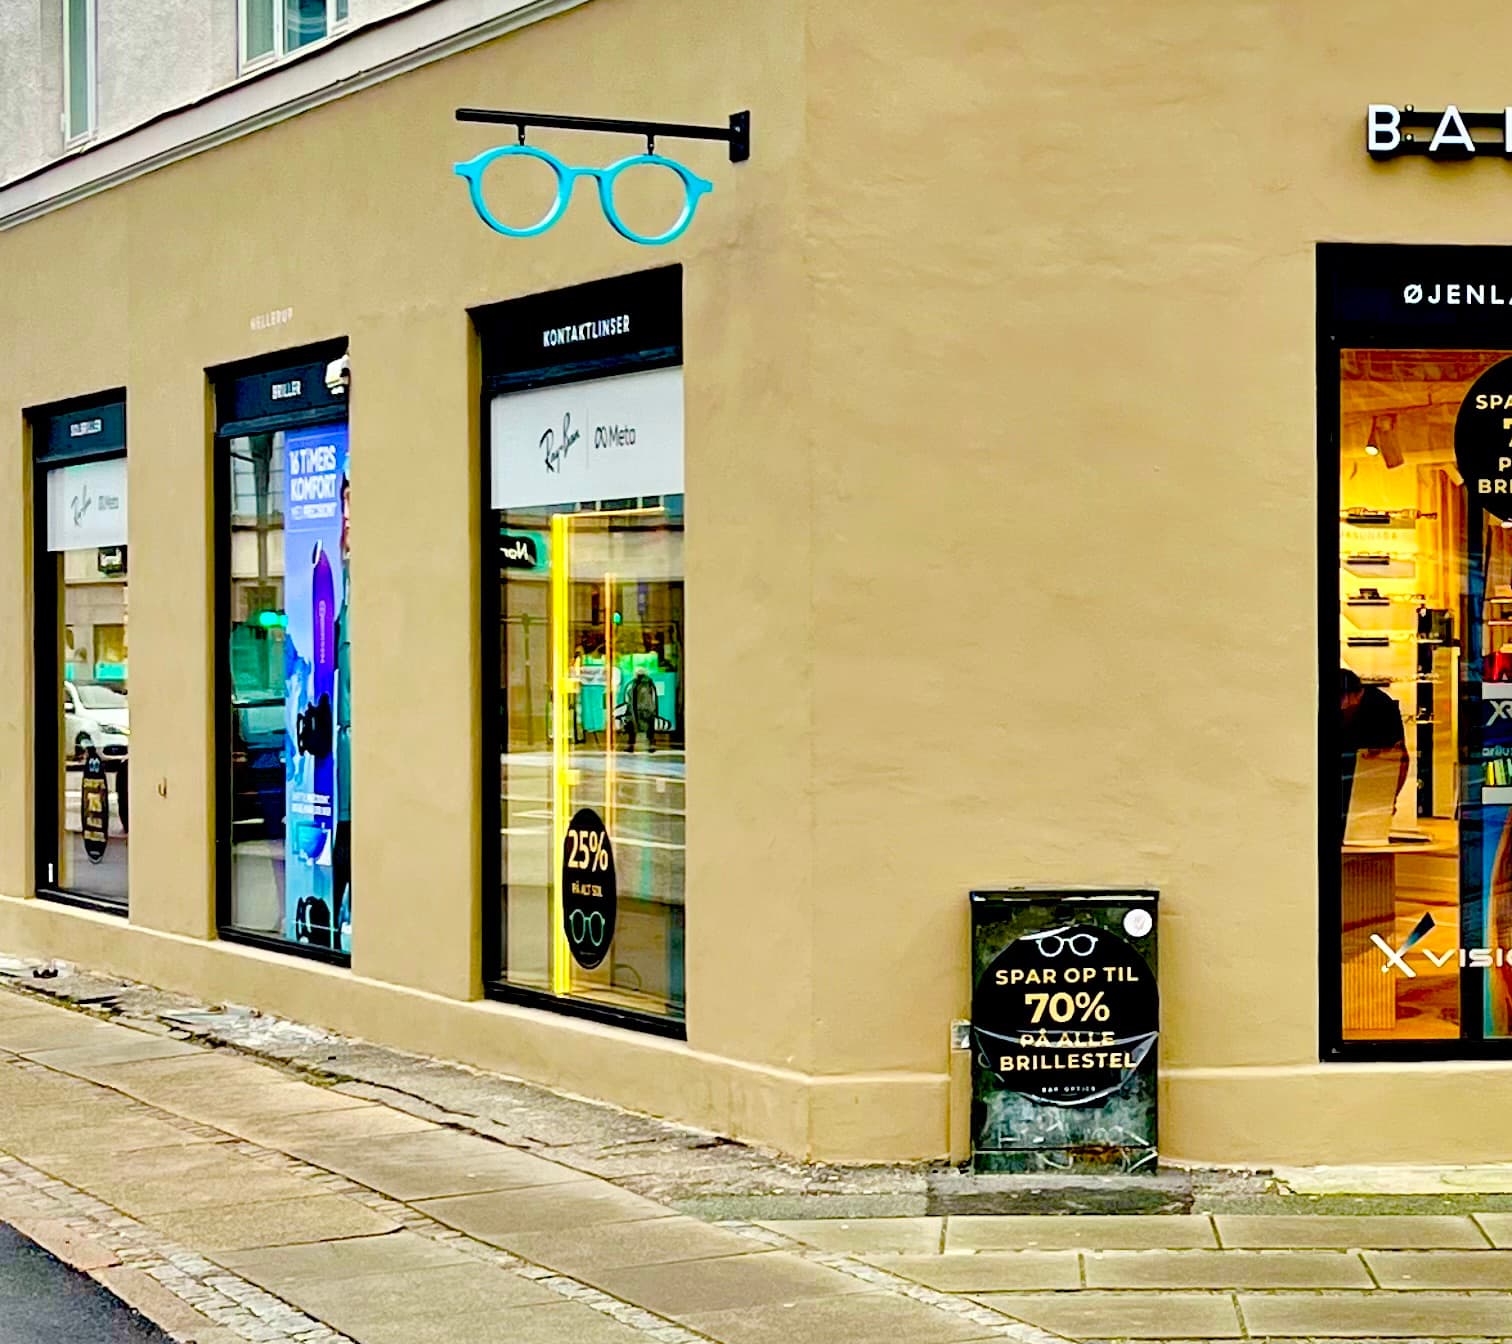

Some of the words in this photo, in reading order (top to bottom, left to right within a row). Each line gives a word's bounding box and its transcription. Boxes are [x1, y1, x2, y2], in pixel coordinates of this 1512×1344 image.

[543, 315, 630, 347] KONTAKTLINSER
[539, 412, 581, 474] Ray-Ban
[609, 425, 636, 448] Meta
[290, 473, 337, 502] KOMFORT
[567, 829, 609, 872] 25%
[995, 969, 1057, 985] SPAR
[1063, 967, 1097, 984] OP
[1102, 966, 1139, 983] TIL
[1024, 991, 1110, 1024] 70%
[1019, 1028, 1050, 1048] PÅ
[1057, 1031, 1115, 1048] ALLE
[1000, 1052, 1137, 1072] BRILLESTEL
